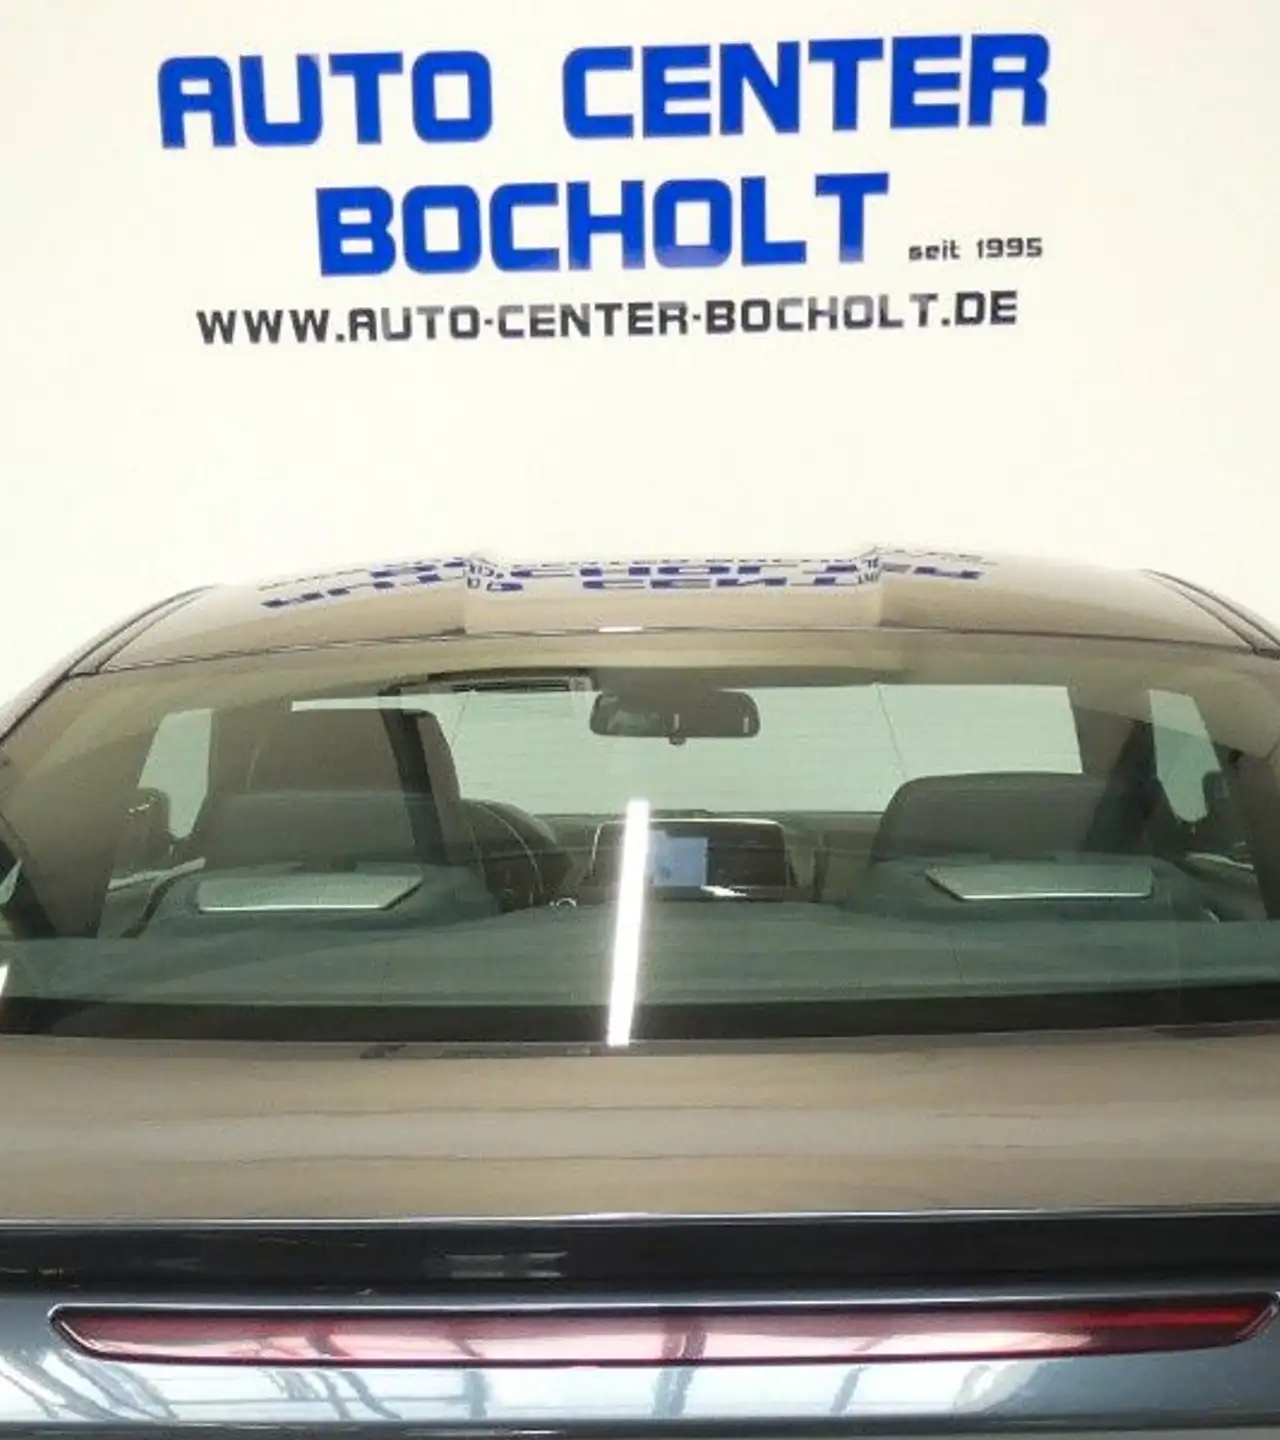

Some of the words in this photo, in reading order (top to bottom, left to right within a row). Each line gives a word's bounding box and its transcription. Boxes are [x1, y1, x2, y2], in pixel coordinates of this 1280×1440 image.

[157, 50, 493, 149] AUTO
[563, 33, 1050, 140] CENTER
[315, 171, 890, 278] BOCHOLT
[908, 239, 961, 262] seit
[976, 237, 1043, 260] 1995
[195, 290, 1018, 346] WWW.AUTO-CENTER-BOCHOLT.DE
